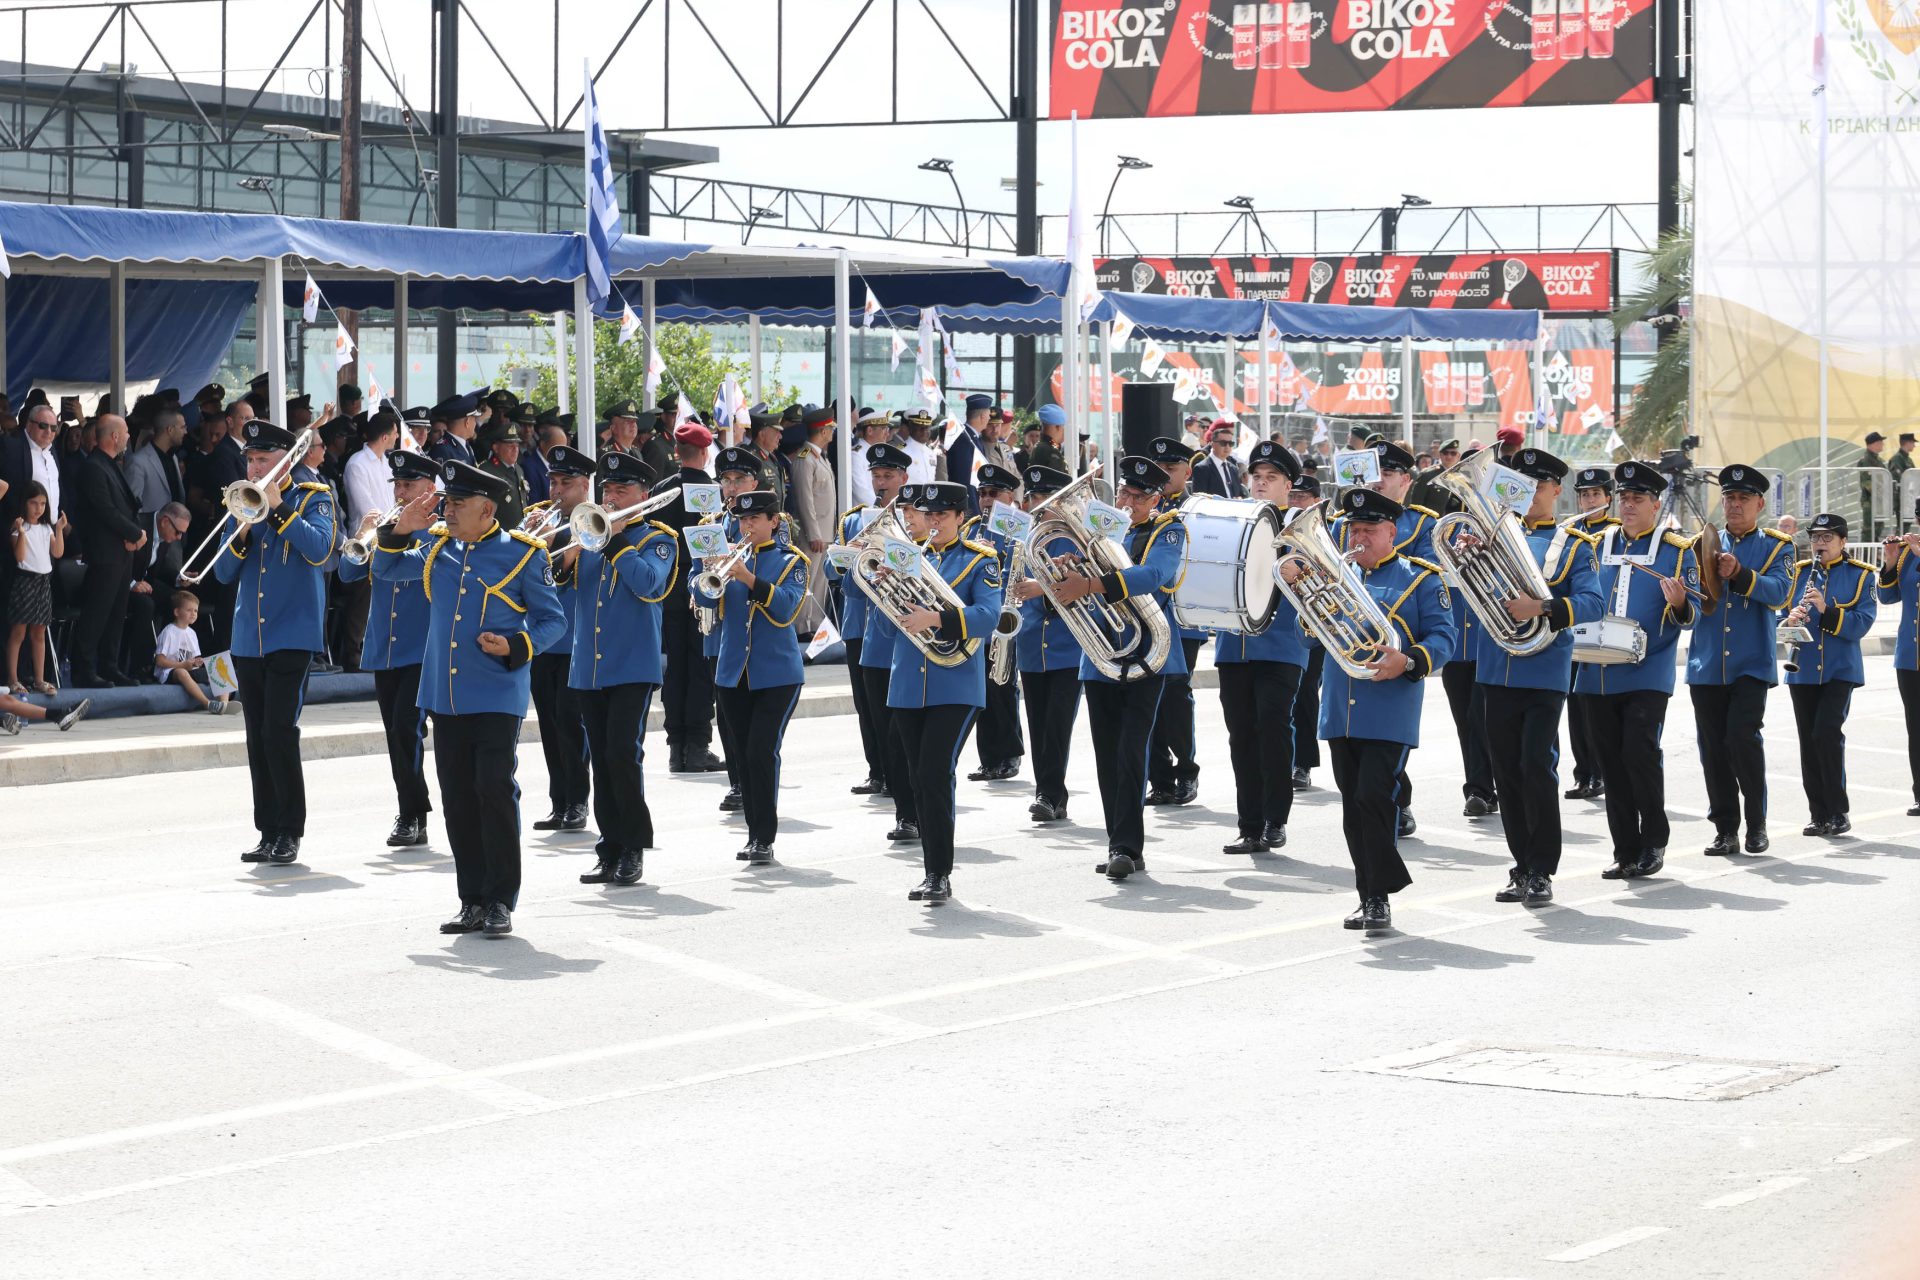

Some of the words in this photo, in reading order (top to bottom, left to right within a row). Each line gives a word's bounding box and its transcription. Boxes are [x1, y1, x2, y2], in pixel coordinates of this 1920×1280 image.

[1347, 0, 1455, 29] ΒΙΚΟΣ
[1062, 8, 1165, 39] ΒΙΚΟΣ
[1350, 29, 1450, 60] COLA
[1065, 39, 1160, 70] COLA
[1165, 270, 1216, 285] ΒΙΚΟΣ
[1344, 269, 1395, 284] ΒΙΚΟΣ
[1542, 265, 1595, 281] ΒΙΚΟΣ
[1166, 285, 1213, 298] COLA
[1345, 284, 1393, 298] COLA
[1429, 288, 1490, 297] ΠΑΡΑΔΟΞΟ
[1543, 280, 1593, 296] COLA
